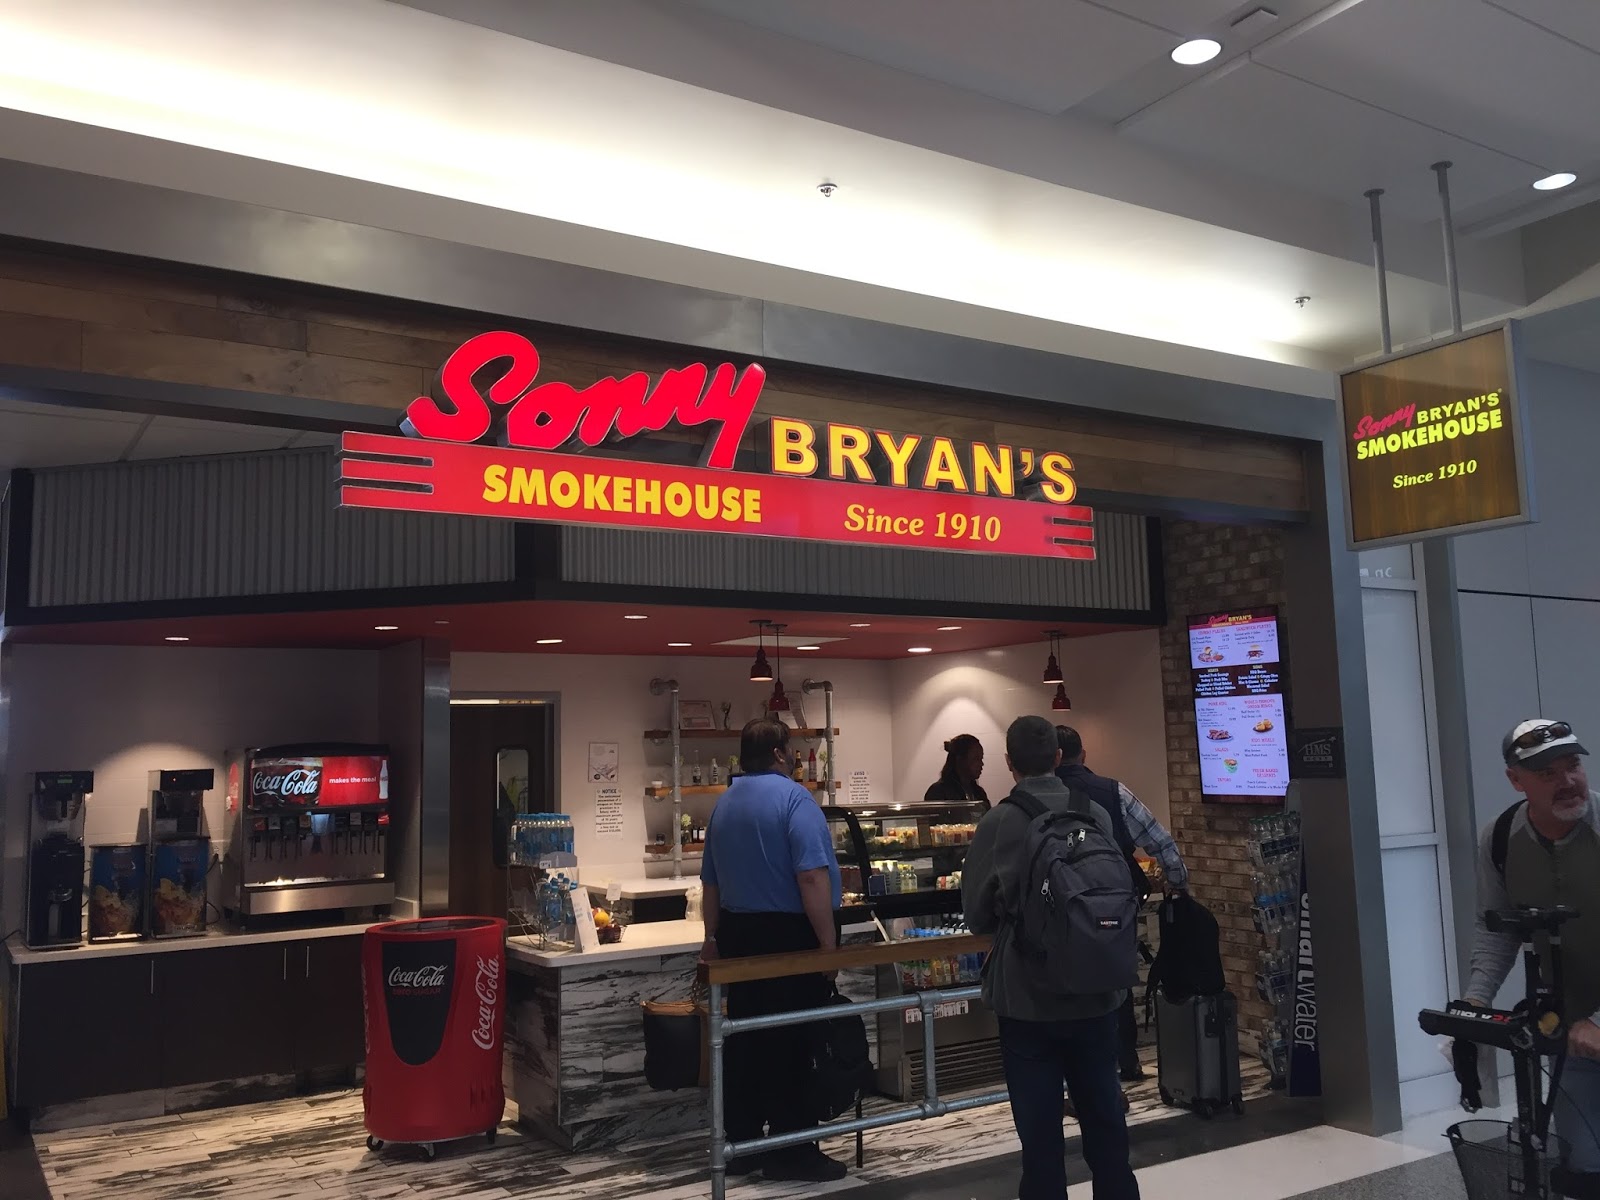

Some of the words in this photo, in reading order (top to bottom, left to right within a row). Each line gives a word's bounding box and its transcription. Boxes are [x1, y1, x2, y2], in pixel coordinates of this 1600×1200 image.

[405, 330, 767, 470] Sonny
[770, 415, 1077, 505] BRYAN'S
[1353, 402, 1417, 440] Sonny
[1416, 391, 1500, 425] BRYAN'S
[1356, 408, 1503, 460] SMOKEHOUSE
[482, 464, 763, 524] SMOKEHOUSE
[1392, 470, 1434, 490] Since
[1437, 459, 1478, 481] 1910
[843, 502, 926, 538] Since
[932, 511, 1002, 543] 1910
[1304, 743, 1331, 756] HMS
